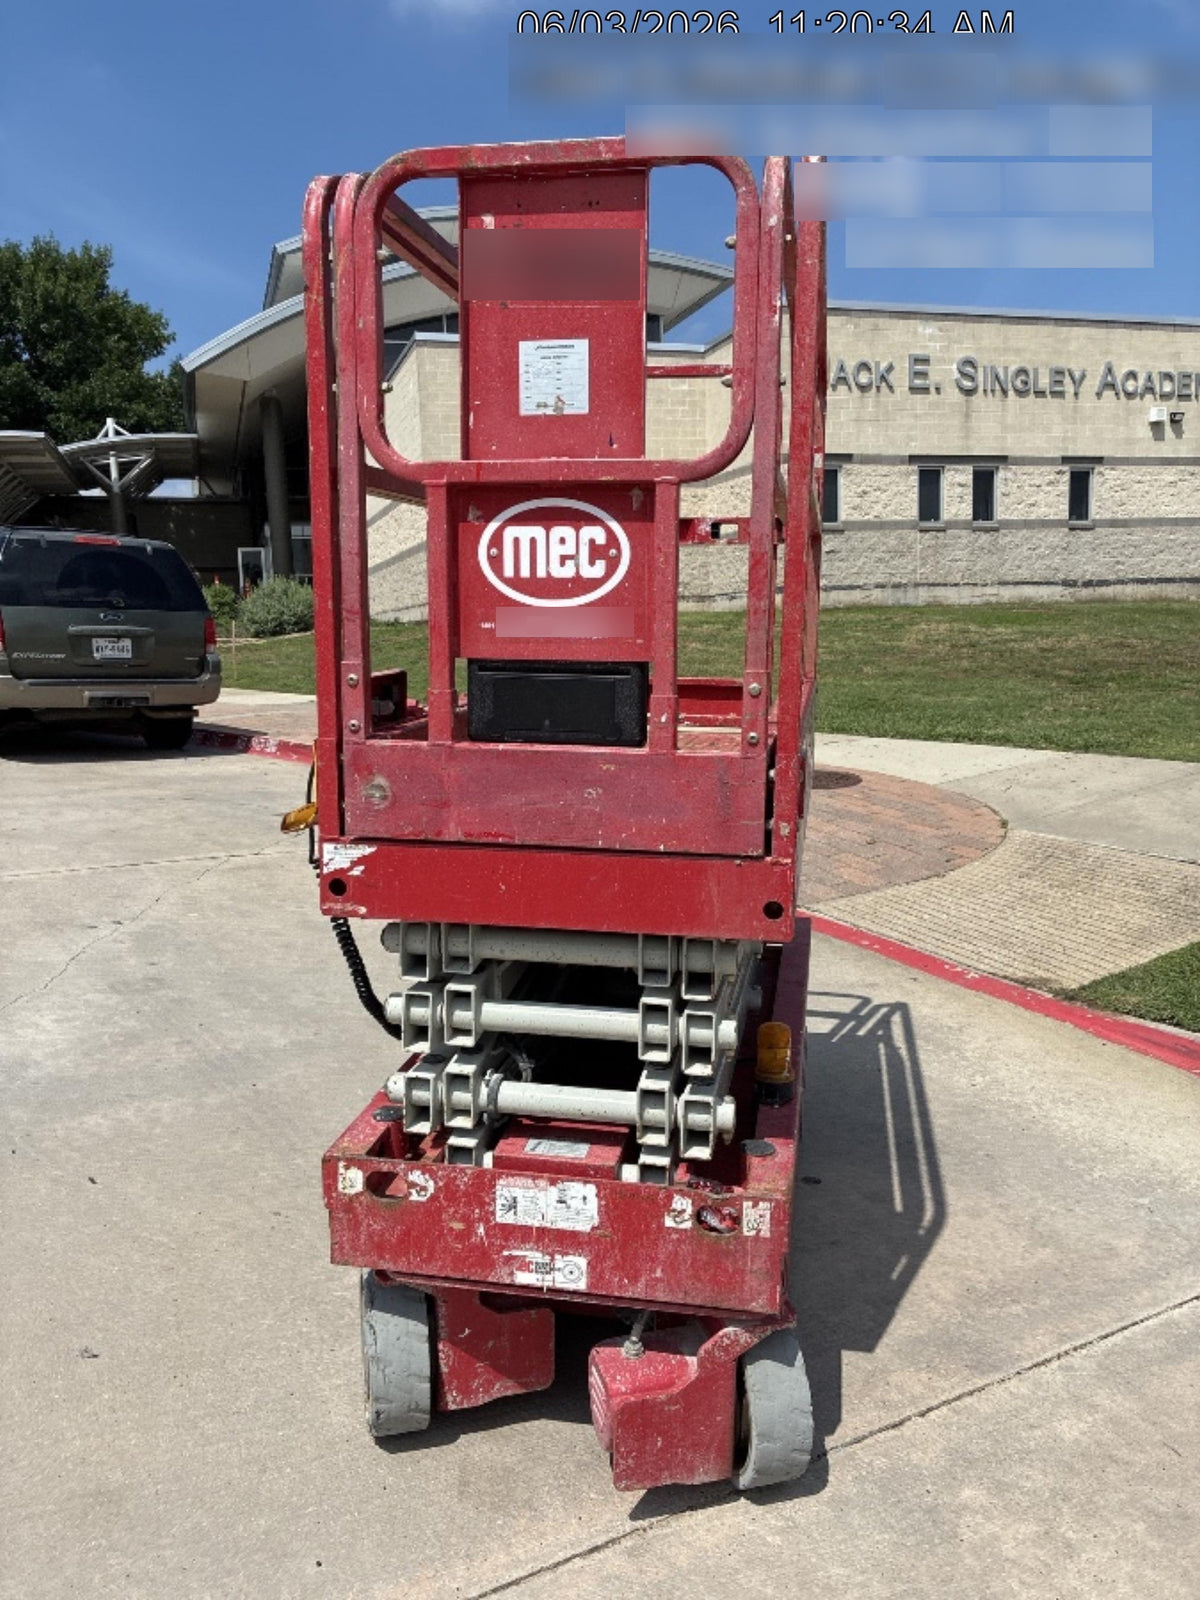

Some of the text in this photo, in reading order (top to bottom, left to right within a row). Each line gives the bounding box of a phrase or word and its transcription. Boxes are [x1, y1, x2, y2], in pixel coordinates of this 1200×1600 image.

[829, 358, 896, 392] ACK
[908, 353, 941, 391] E.
[955, 356, 1087, 396] SINGLEY
